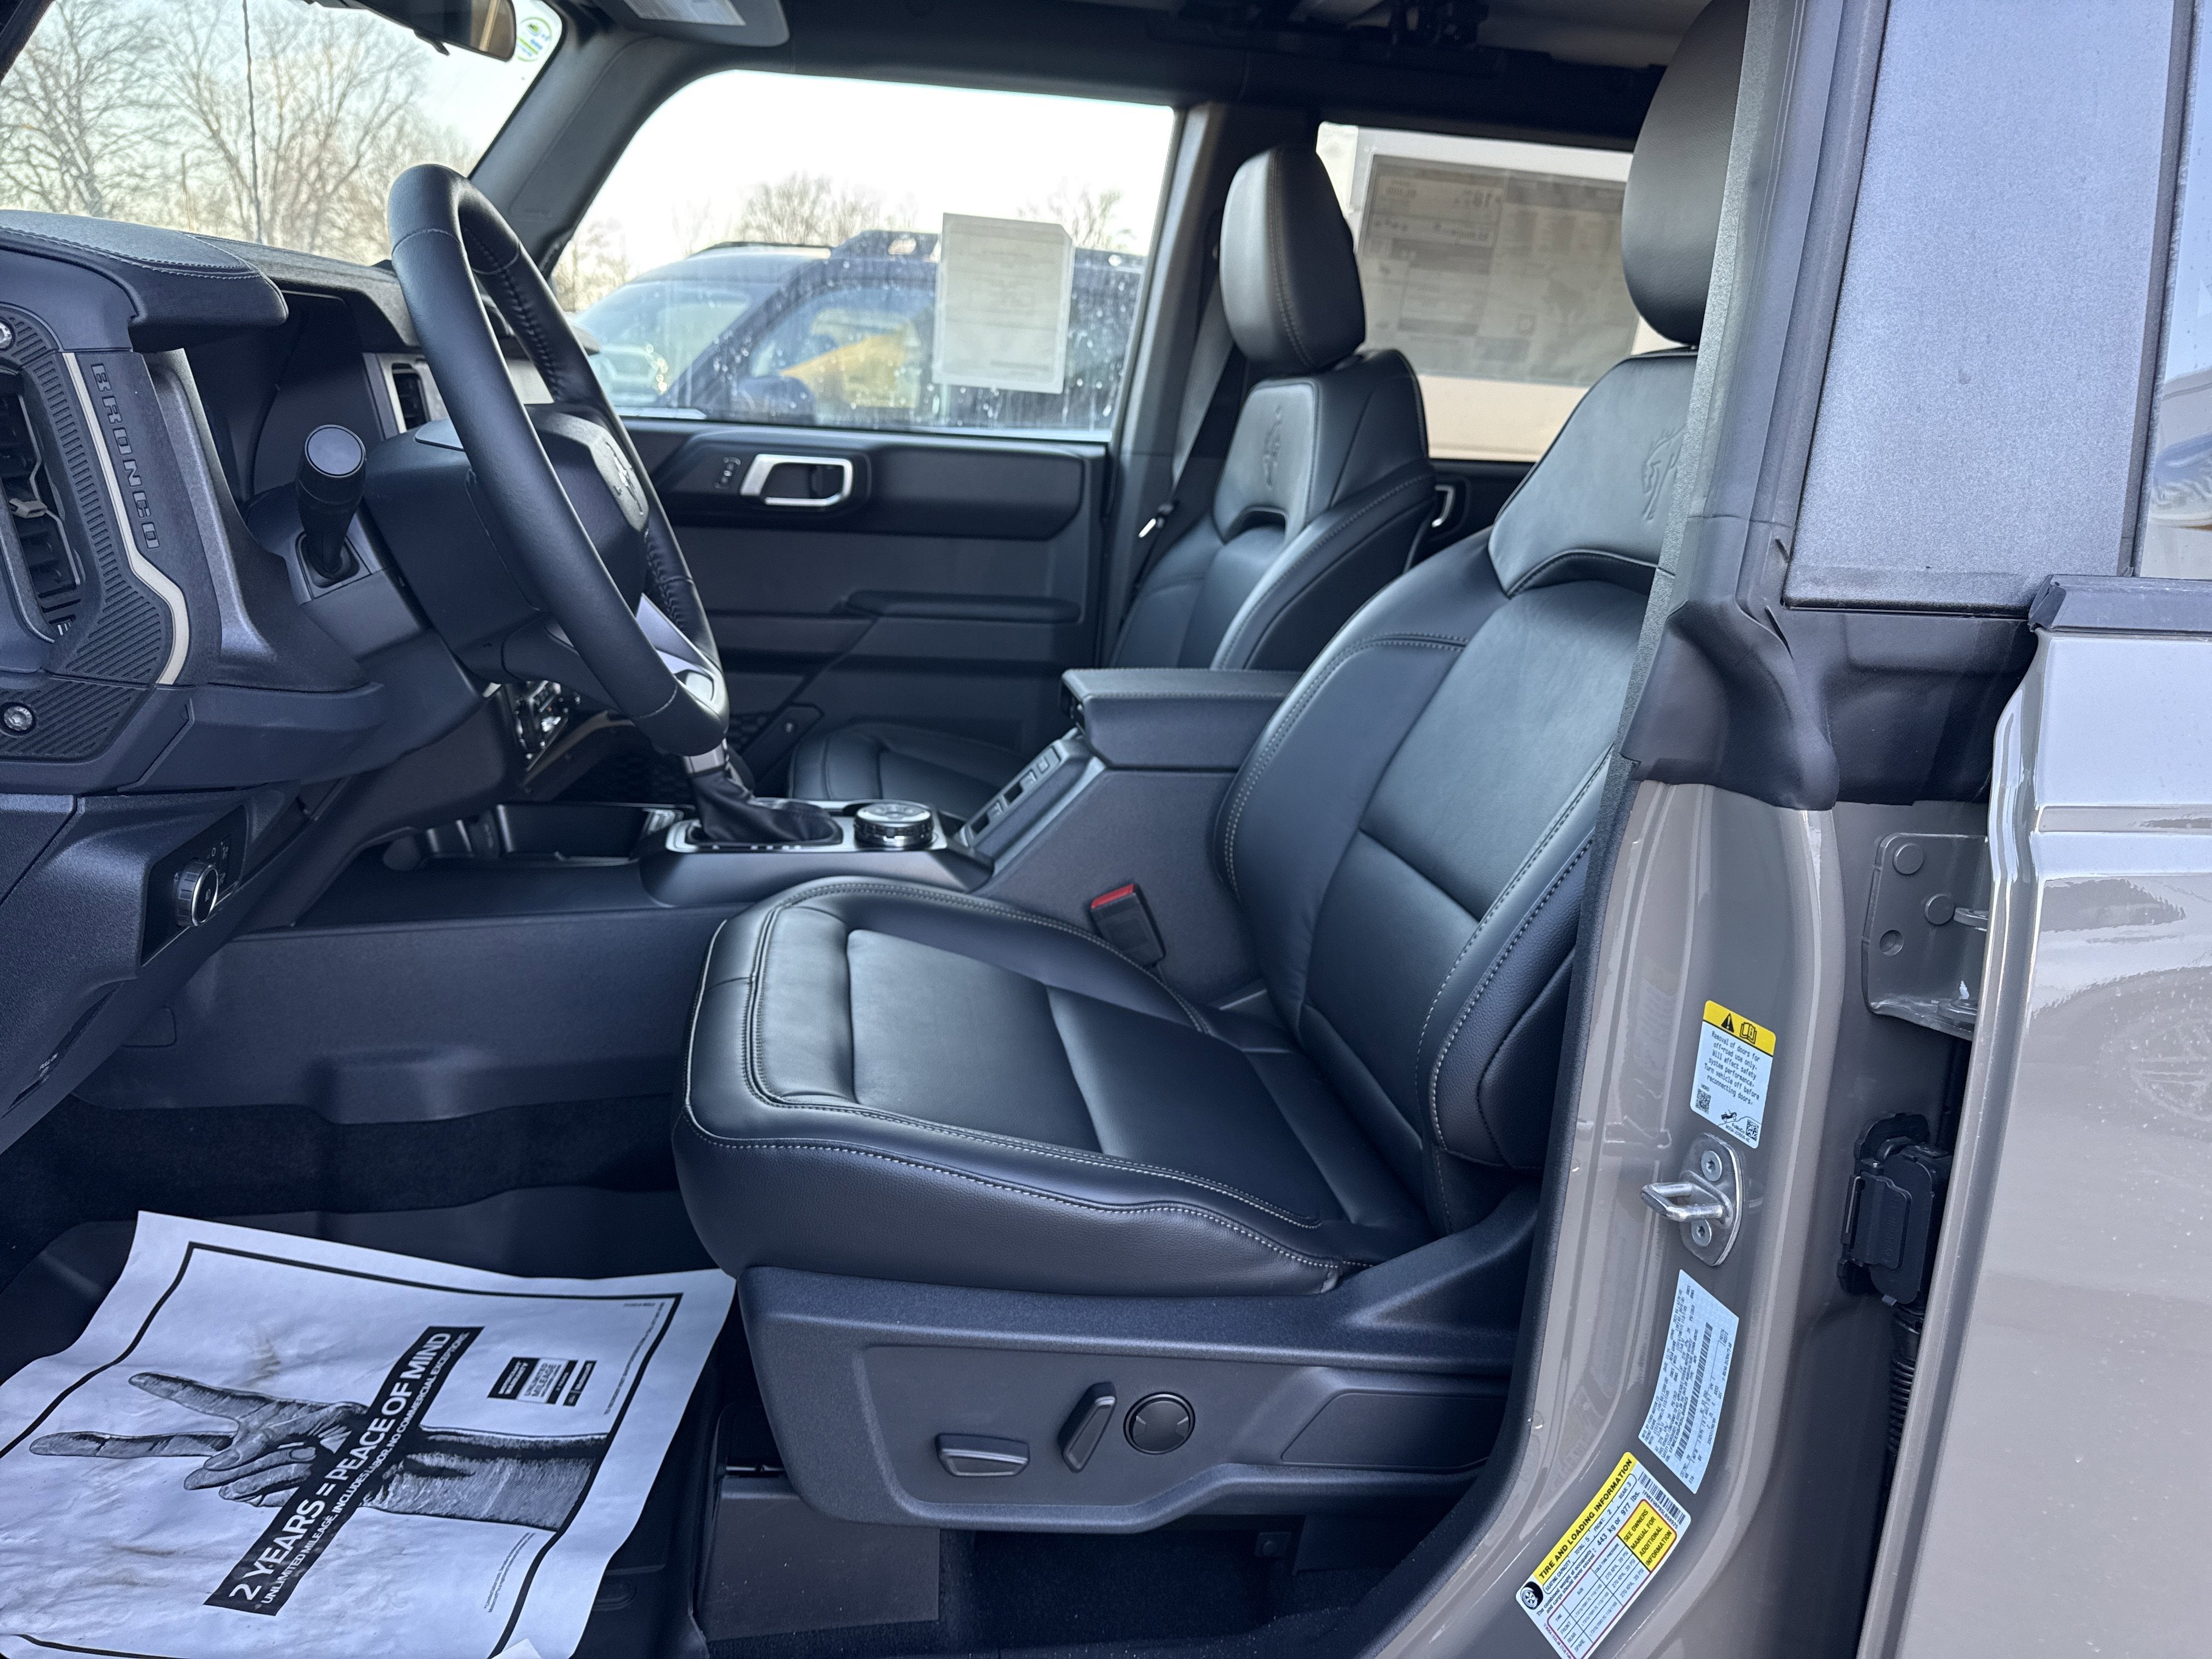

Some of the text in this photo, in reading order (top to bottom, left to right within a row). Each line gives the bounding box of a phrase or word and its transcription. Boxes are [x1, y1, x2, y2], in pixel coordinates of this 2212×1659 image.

[91, 363, 160, 550] BRONCO
[1711, 1030, 1760, 1063] Removal of doors for
[1713, 1041, 1757, 1072] off-road use only.
[1703, 1062, 1759, 1101] Turn vehicle off before
[1708, 1057, 1754, 1089] system performance.
[1712, 1048, 1757, 1081] Will affect safety
[1707, 1073, 1753, 1105] reconnecting doors.
[228, 1335, 451, 1602] 2 YEARS = PEACE OF MIND
[260, 1555, 307, 1602] UNLIMITED
[331, 1472, 369, 1512] INCLUDES
[386, 1434, 402, 1446] NO
[397, 1375, 437, 1431] COMMERCIAL
[1538, 1458, 1632, 1579] TIRE AND LOADING INFORMATION
[1596, 1489, 1640, 1547] 443 kg or 977 lbs.
[1623, 1508, 1649, 1542] SEE OWNERS
[1630, 1515, 1656, 1550] MANUAL FOR
[1545, 1576, 1558, 1591] SEATING
[1556, 1559, 1571, 1577] CAPACITY
[1618, 1486, 1628, 1499] REAR:
[1606, 1542, 1620, 1559] PRESSURE
[1638, 1524, 1663, 1557] ADDITIONAL
[1645, 1529, 1672, 1566] INFORMATION
[1536, 1607, 1544, 1616] The
[1543, 1588, 1560, 1609] combined
[1559, 1574, 1571, 1590] weight
[1574, 1549, 1592, 1571] occupants
[1553, 1593, 1564, 1606] cargo
[1561, 1579, 1574, 1594] should
[1573, 1568, 1583, 1580] never
[1582, 1553, 1595, 1568] exceed
[1560, 1620, 1572, 1635] FRONT
[1567, 1632, 1577, 1643] REAR
[1573, 1638, 1585, 1652] SPARE
